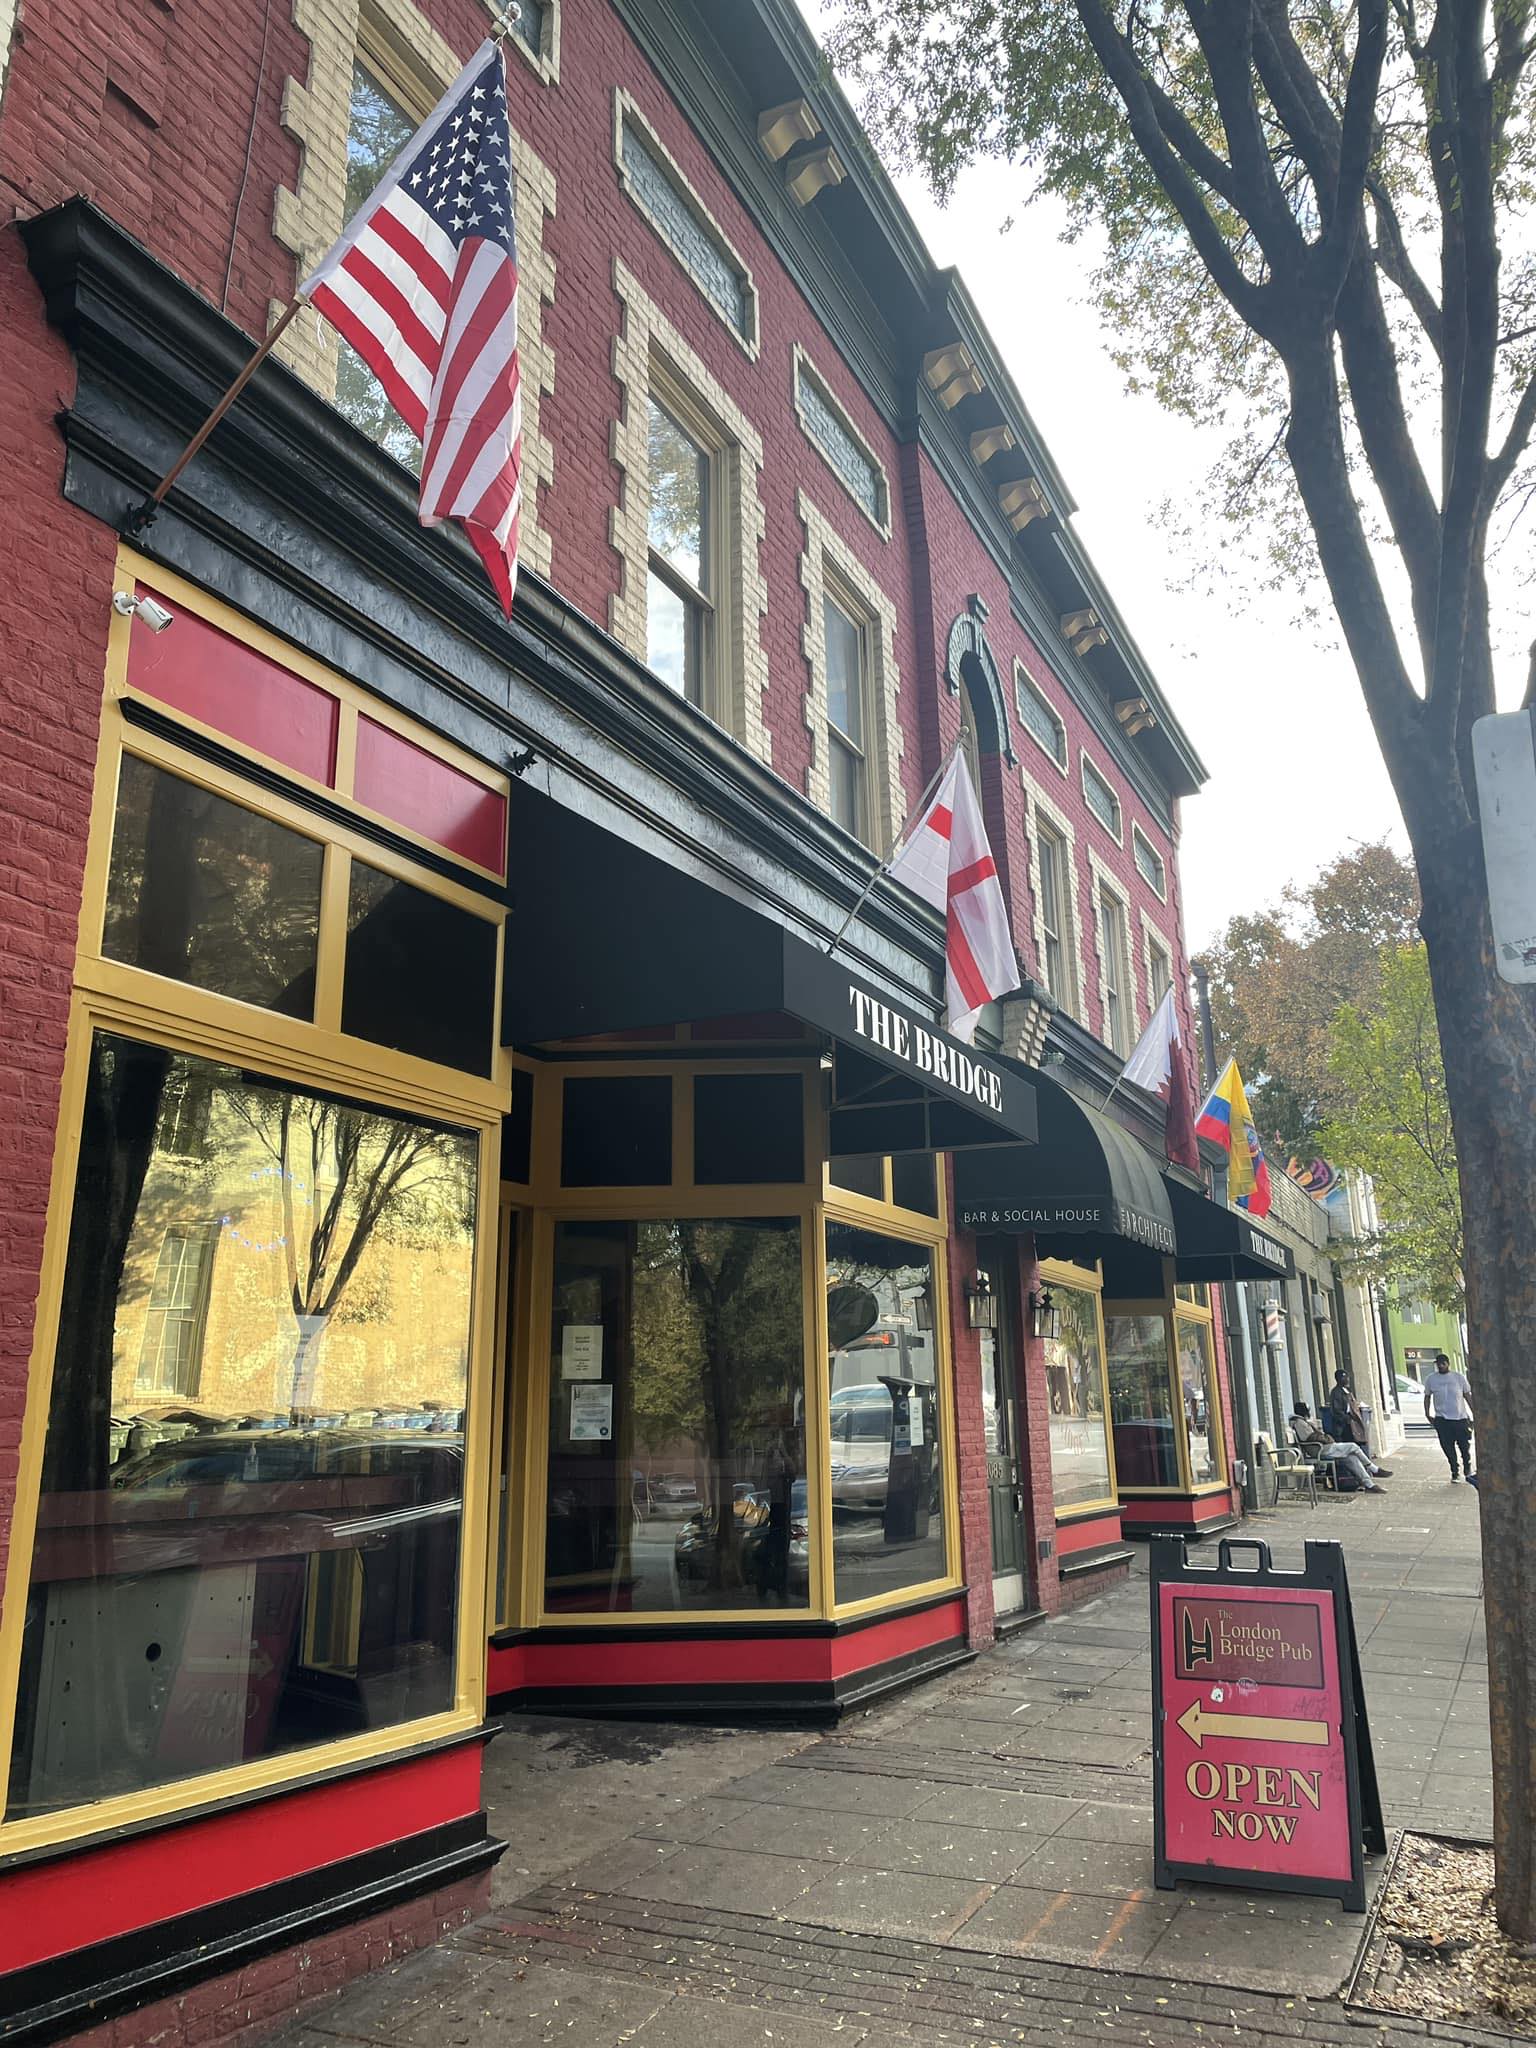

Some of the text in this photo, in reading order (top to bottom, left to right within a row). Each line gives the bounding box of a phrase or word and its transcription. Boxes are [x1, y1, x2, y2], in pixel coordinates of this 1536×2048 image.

[850, 985, 1002, 1112] THE BRIDGE
[964, 1209, 1101, 1223] BAR & SOCIAL HOUSE
[1126, 1210, 1173, 1248] ARCHITECT
[1218, 1609, 1233, 1619] The
[1220, 1620, 1281, 1640] London
[1220, 1638, 1312, 1662] Bridge Pub
[1186, 1760, 1322, 1811] OPEN
[1212, 1808, 1299, 1845] NOW
